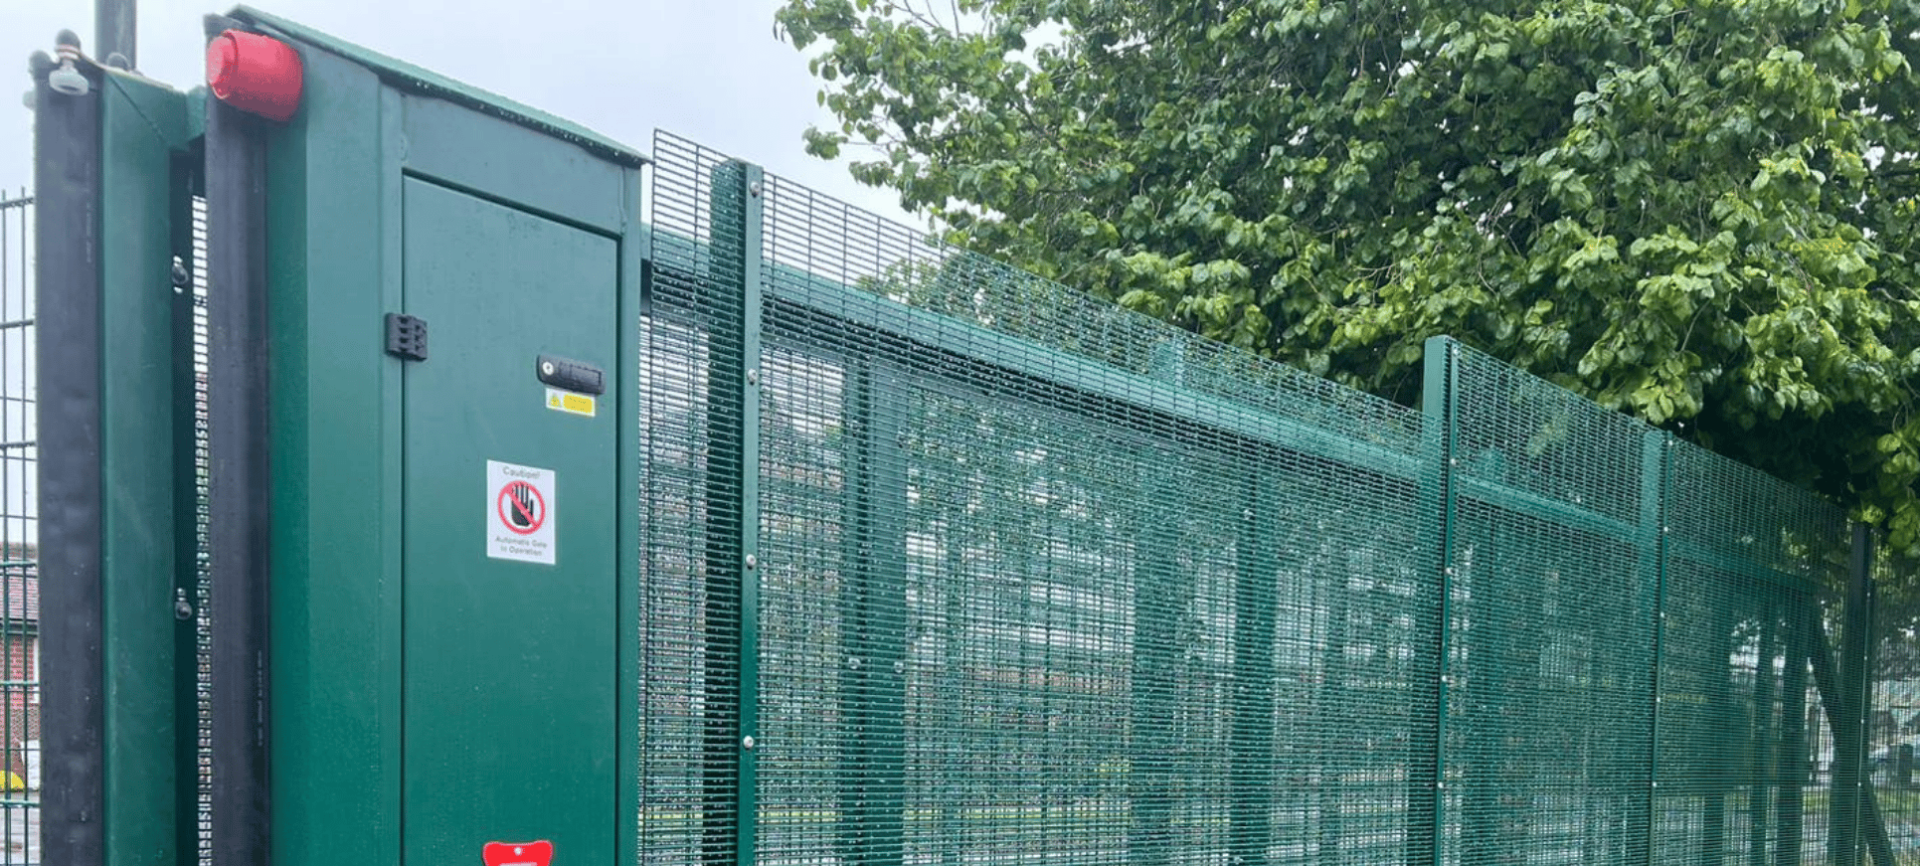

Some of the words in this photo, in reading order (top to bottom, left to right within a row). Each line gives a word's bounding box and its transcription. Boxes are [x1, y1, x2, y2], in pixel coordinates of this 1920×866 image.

[502, 466, 540, 479] Caution!
[495, 535, 530, 546] Automatic
[531, 539, 548, 549] Gate
[508, 545, 542, 556] Operation
